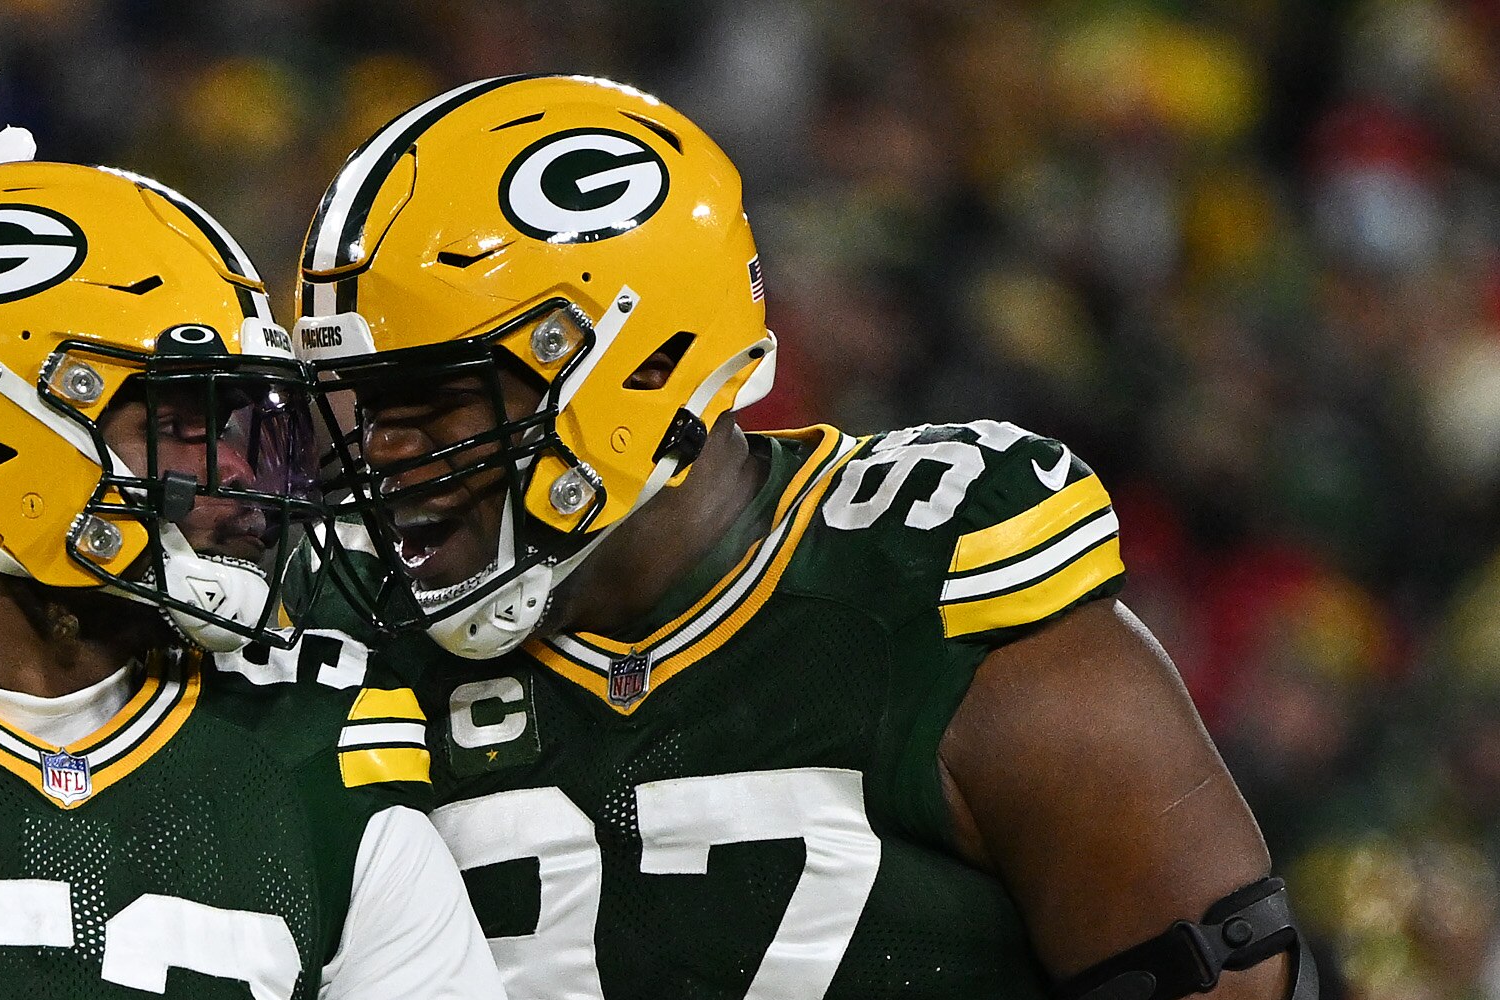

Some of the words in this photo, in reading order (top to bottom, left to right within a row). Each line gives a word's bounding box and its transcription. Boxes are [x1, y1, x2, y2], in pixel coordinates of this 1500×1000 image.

[613, 673, 642, 697] NFL
[449, 676, 527, 749] C
[50, 768, 84, 792] NFL
